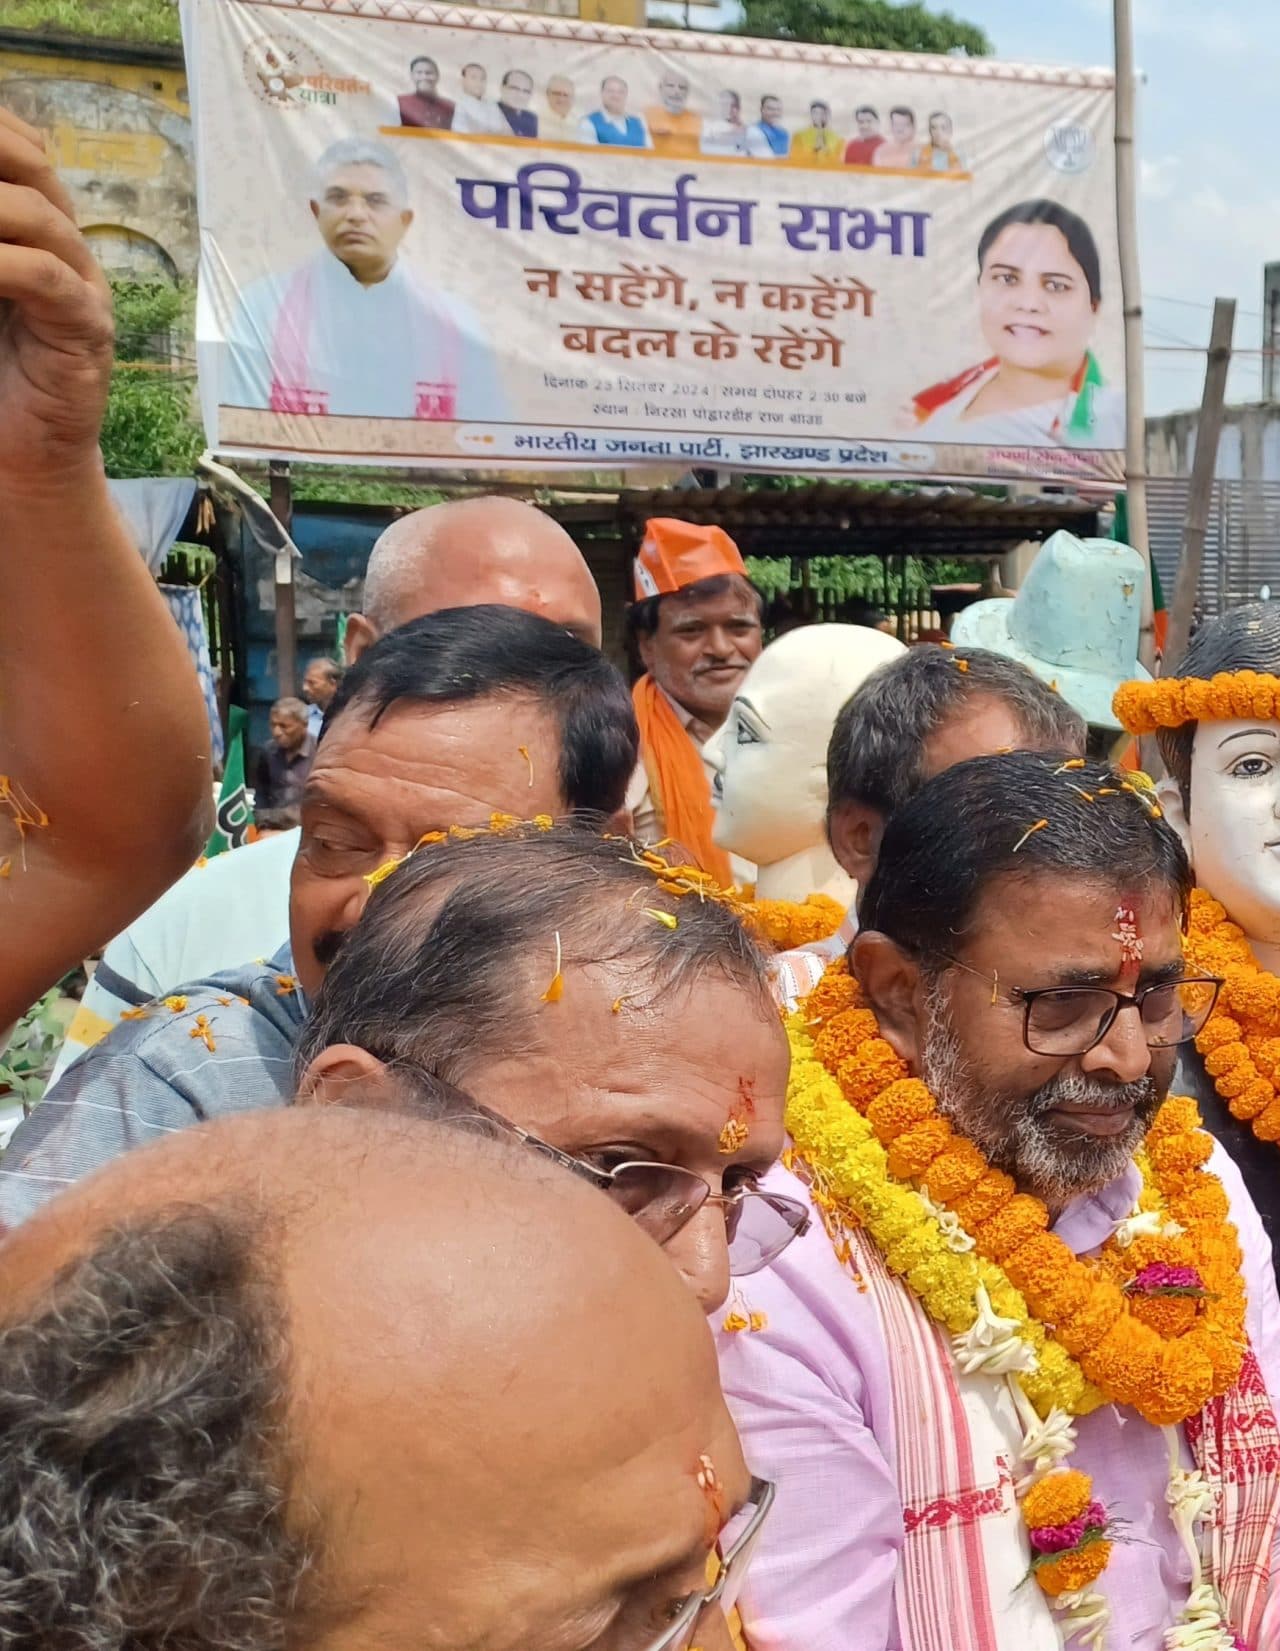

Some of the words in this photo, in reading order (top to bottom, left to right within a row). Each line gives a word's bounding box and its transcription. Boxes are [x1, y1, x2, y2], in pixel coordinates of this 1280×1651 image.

[455, 162, 757, 245] परिवर्तन
[779, 203, 931, 257] सभा
[523, 267, 561, 298] न
[712, 279, 747, 309] न
[758, 274, 876, 319] कहेंगे
[560, 323, 679, 359] बदल
[689, 320, 740, 360] के
[751, 324, 845, 370] रहेंगे
[543, 372, 588, 389] दिनाक
[618, 376, 665, 393] सितबर
[672, 384, 710, 396] 2024
[514, 431, 597, 451] भारतीय
[606, 439, 671, 454] जनता
[838, 444, 888, 463] प्रदेश
